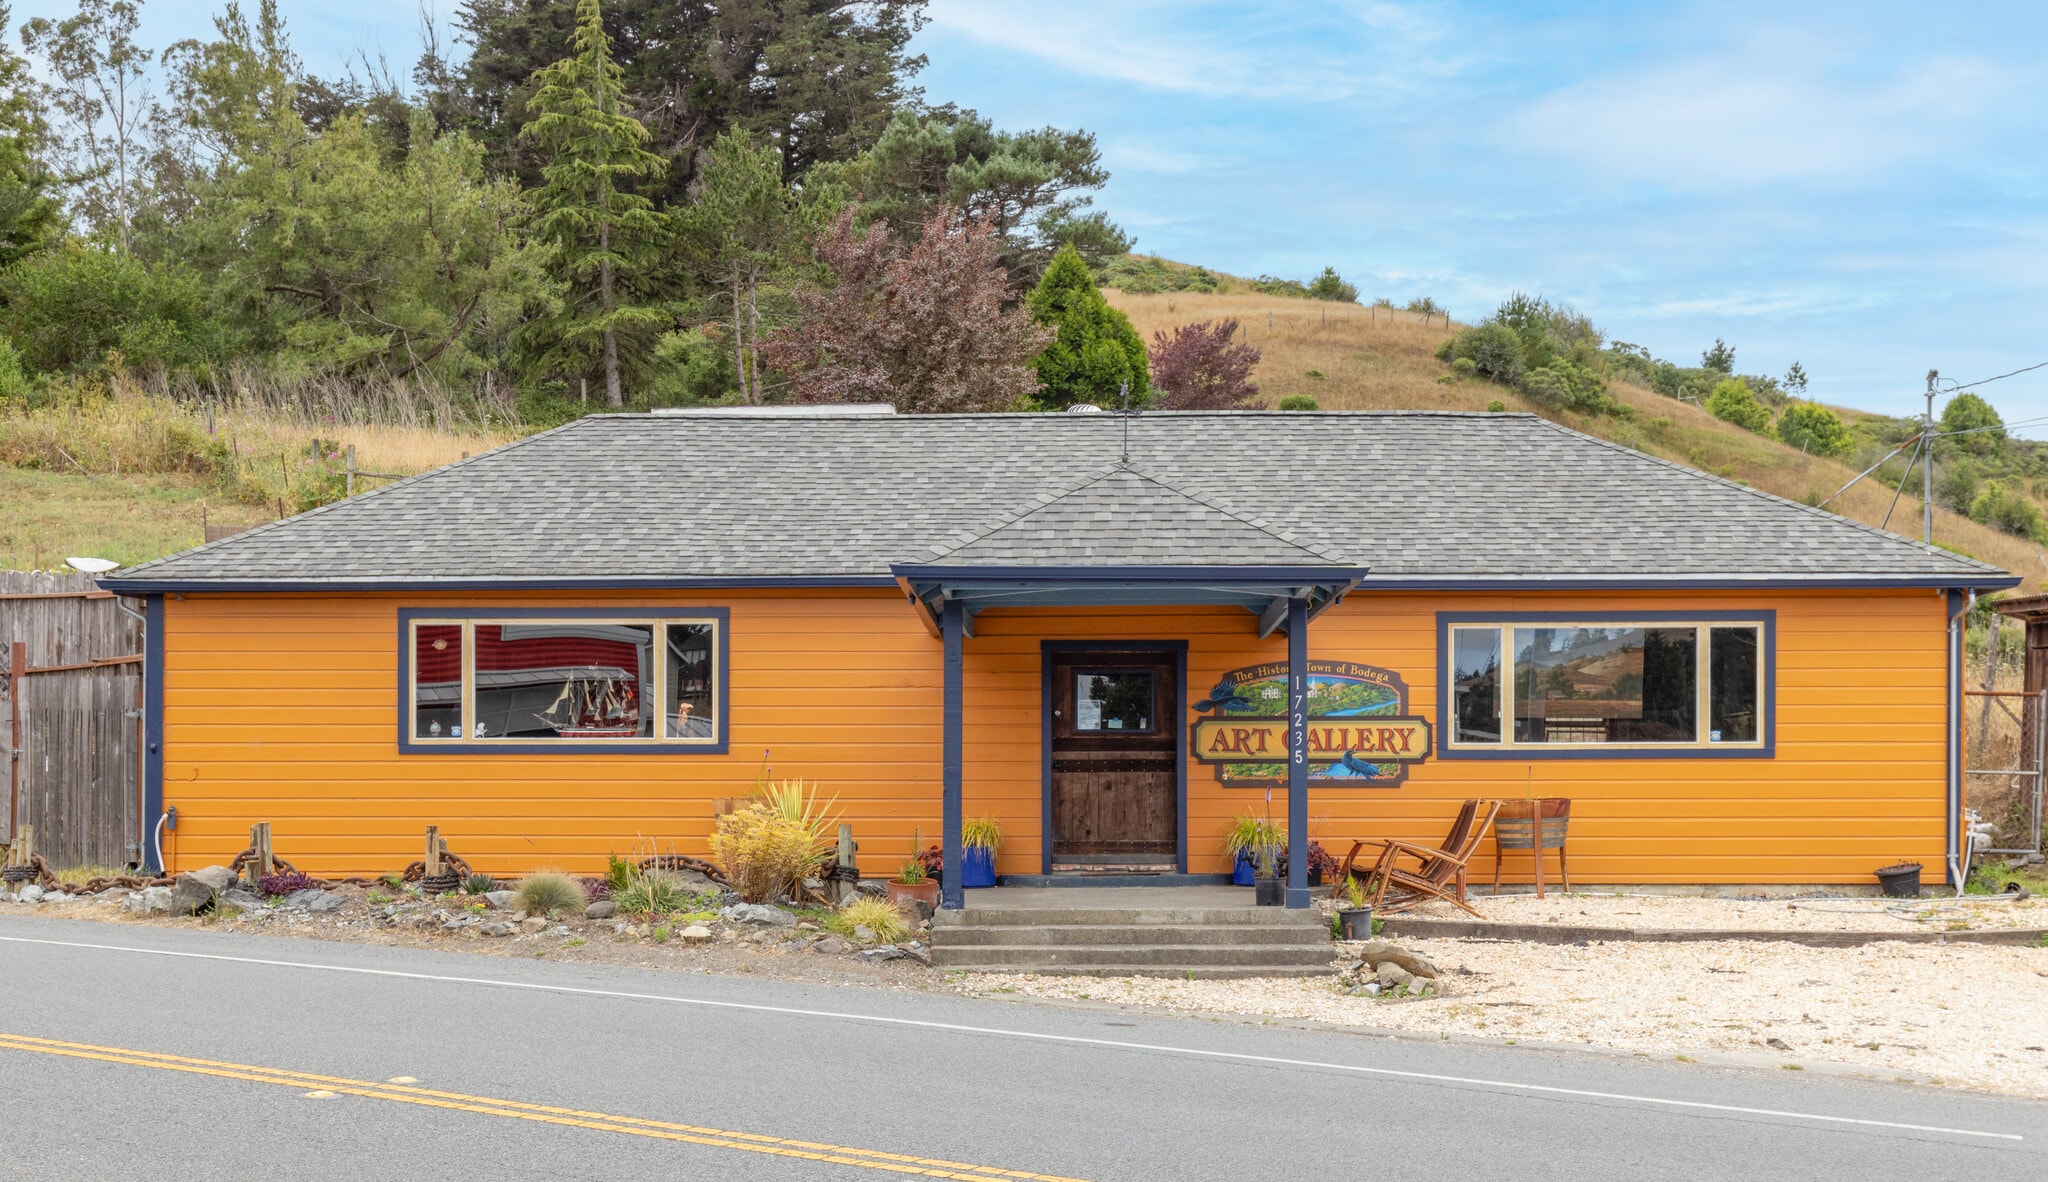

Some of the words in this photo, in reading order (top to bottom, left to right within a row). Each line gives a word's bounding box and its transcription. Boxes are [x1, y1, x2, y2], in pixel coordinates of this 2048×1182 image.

[1233, 671, 1254, 682] The
[1306, 661, 1331, 673] Town
[1336, 664, 1347, 673] of
[1350, 664, 1389, 682] Bodega
[1294, 675, 1303, 764] 17235
[1208, 727, 1273, 755] ART
